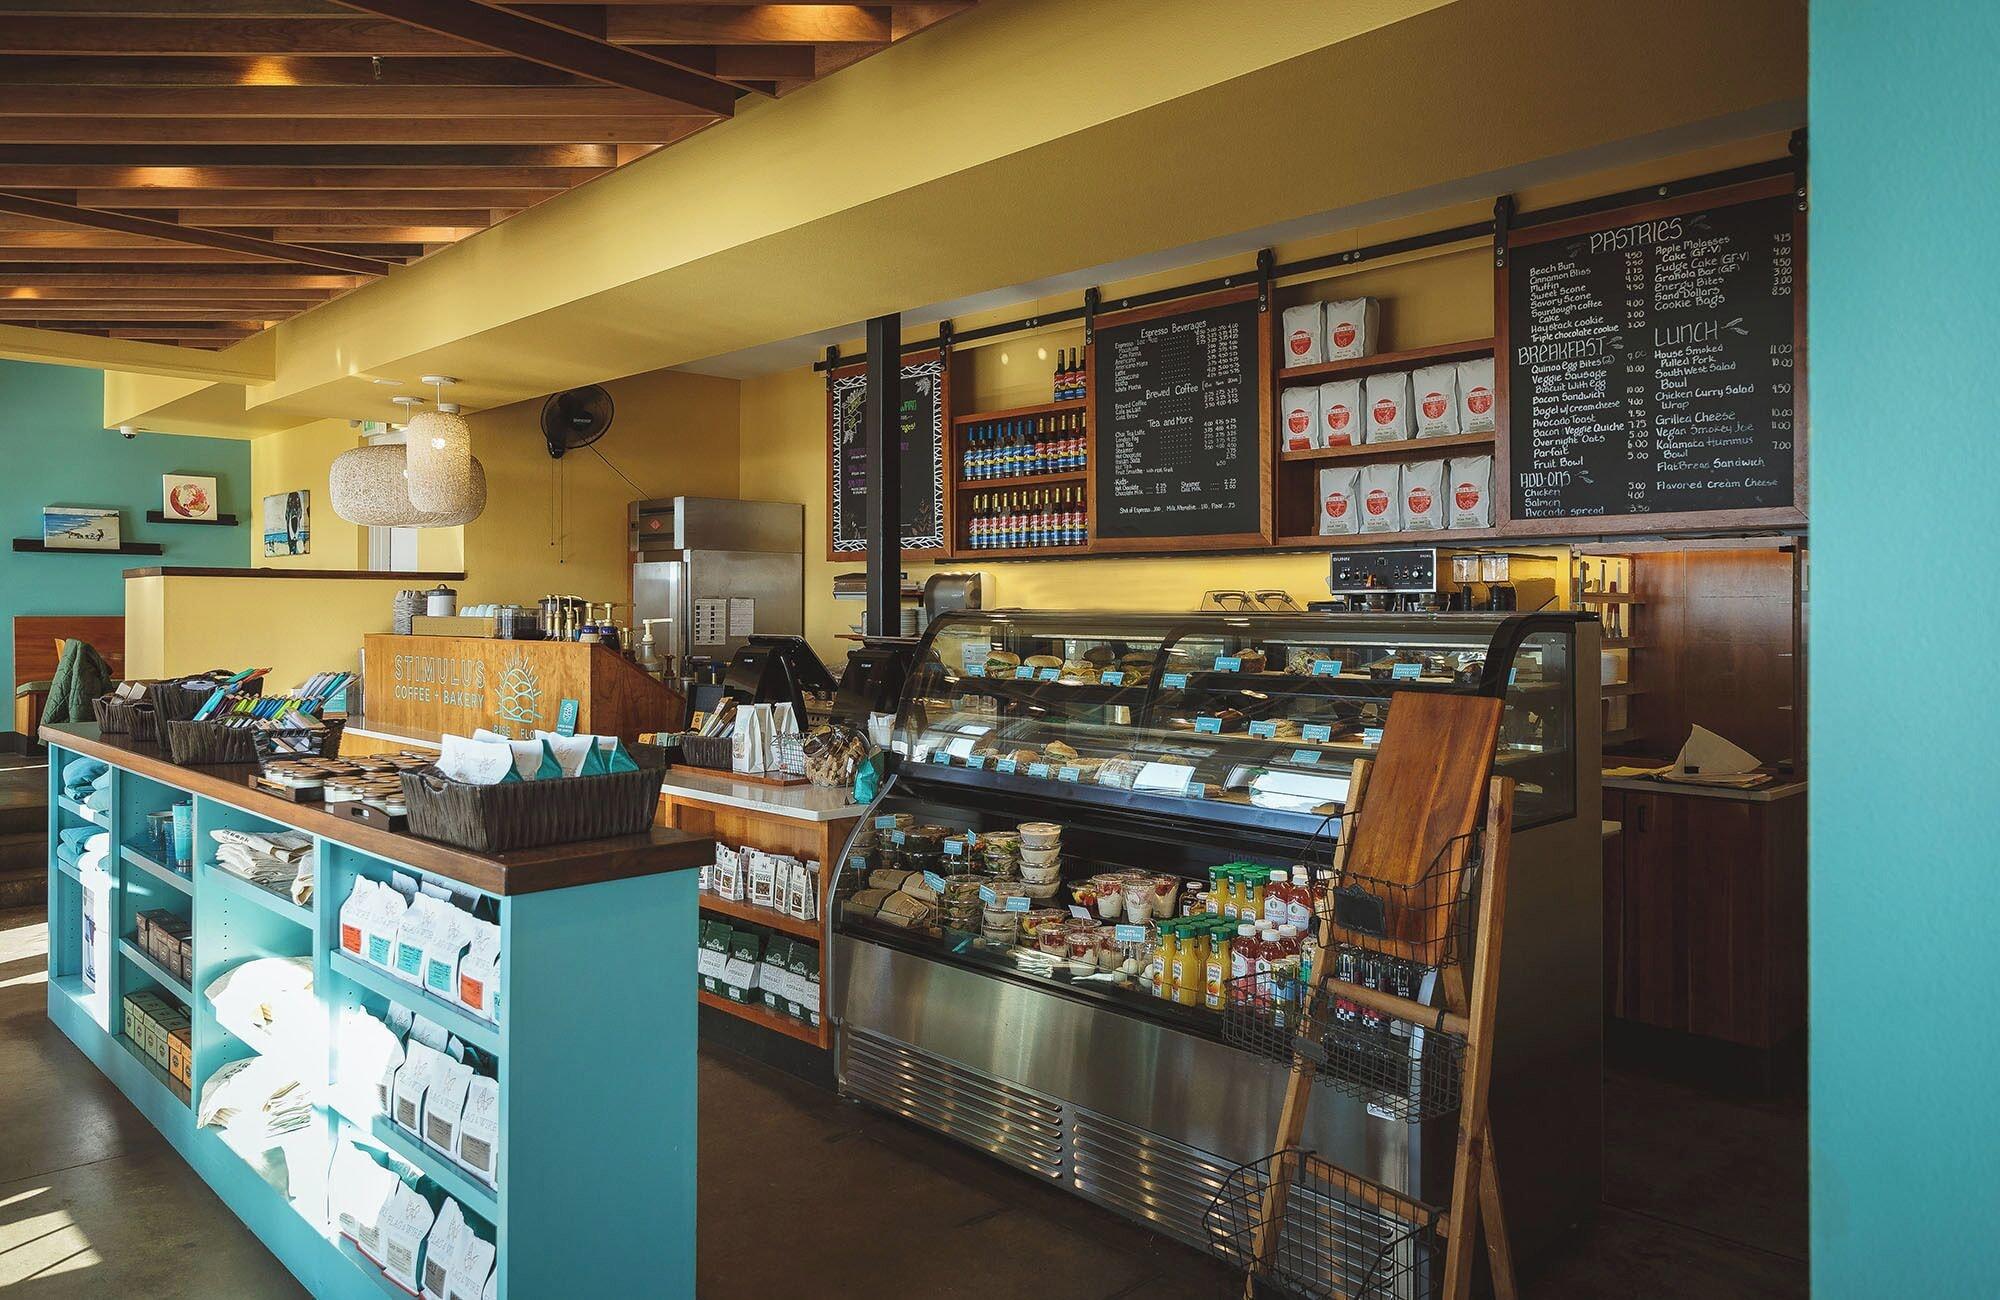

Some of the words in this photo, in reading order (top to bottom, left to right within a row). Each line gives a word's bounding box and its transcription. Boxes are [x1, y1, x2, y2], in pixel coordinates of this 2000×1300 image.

[1656, 245, 1681, 255] Apple
[1662, 253, 1686, 262] Cake
[1530, 265, 1556, 276] Beach
[1558, 262, 1575, 271] Bun
[1656, 263, 1687, 274] Fudge
[1691, 258, 1717, 269] Cake
[1530, 273, 1568, 284] Cinnamon
[1570, 268, 1591, 277] Bliss
[1655, 271, 1695, 282] Granola
[1698, 267, 1715, 278] Bar
[1697, 277, 1724, 286] Bites
[1530, 291, 1557, 301] Sweet
[1560, 285, 1586, 295] Scone
[1655, 292, 1679, 301] Sand
[1683, 287, 1720, 298] Dollars
[1530, 298, 1562, 309] Savory
[1564, 293, 1591, 302] Scone
[1655, 300, 1691, 311] Cookie
[1696, 295, 1725, 308] Bags
[1531, 305, 1577, 318] Sourdough
[1141, 329, 1168, 339] Espresso
[1172, 320, 1207, 333] Beverages
[1531, 333, 1553, 343] Triple
[1554, 328, 1592, 339] chocolate
[1593, 324, 1619, 334] cookie
[1655, 350, 1683, 359] House
[1686, 344, 1723, 356] Smoked
[1531, 365, 1561, 374] Quinoa
[1579, 359, 1601, 368] Bites
[1602, 354, 1615, 365] (2)
[1661, 358, 1689, 367] Pulled
[1692, 355, 1716, 364] Pork
[1655, 369, 1683, 379] South
[1684, 366, 1708, 375] West
[1709, 361, 1736, 372] Salad
[1532, 374, 1562, 386] Veggie
[1565, 370, 1607, 381] Sausage
[1661, 379, 1687, 390] Bowl
[1146, 388, 1170, 400] Brewed
[1175, 383, 1198, 395] Coffee
[1535, 384, 1565, 394] Biscuit
[1656, 391, 1693, 401] Chicken
[1695, 387, 1723, 398] Curry
[1725, 384, 1754, 394] Salad
[1533, 396, 1559, 404] Bacon
[1562, 391, 1605, 402] Sandwich
[1533, 406, 1558, 419] Bagel
[1662, 401, 1689, 410] Wrap
[1147, 418, 1160, 428] Tea
[1164, 417, 1175, 426] and
[1176, 416, 1194, 424] More
[1533, 418, 1570, 427] Avocado
[1570, 414, 1596, 423] Toast
[1656, 415, 1691, 425] Grilled
[1695, 411, 1735, 423] Cheese
[1533, 429, 1559, 437] Bacon
[1565, 425, 1591, 436] Veggie
[1593, 422, 1625, 432] Quiche
[1656, 428, 1686, 441] Vegan
[1690, 424, 1732, 436] Smokey
[1533, 437, 1578, 450] Overnight
[1582, 434, 1605, 443] Oats
[1656, 440, 1704, 450] Kalamata
[1706, 436, 1753, 448] Hummus
[1534, 448, 1569, 458] Parfait
[1663, 450, 1688, 459] Bowl
[1534, 460, 1556, 469] Fruit
[1560, 456, 1583, 467] Bowl
[1714, 458, 1765, 468] Sandwich
[1657, 481, 1702, 490] Flavored
[1745, 478, 1778, 487] Cheese
[1525, 488, 1561, 497] Chicken
[1525, 498, 1561, 507] Salmon
[1526, 509, 1565, 517] Avocado
[394, 654, 485, 689] STIMULUS
[395, 685, 430, 702] COFFEE
[443, 690, 484, 708] BAKERY
[520, 729, 536, 740] FLO
